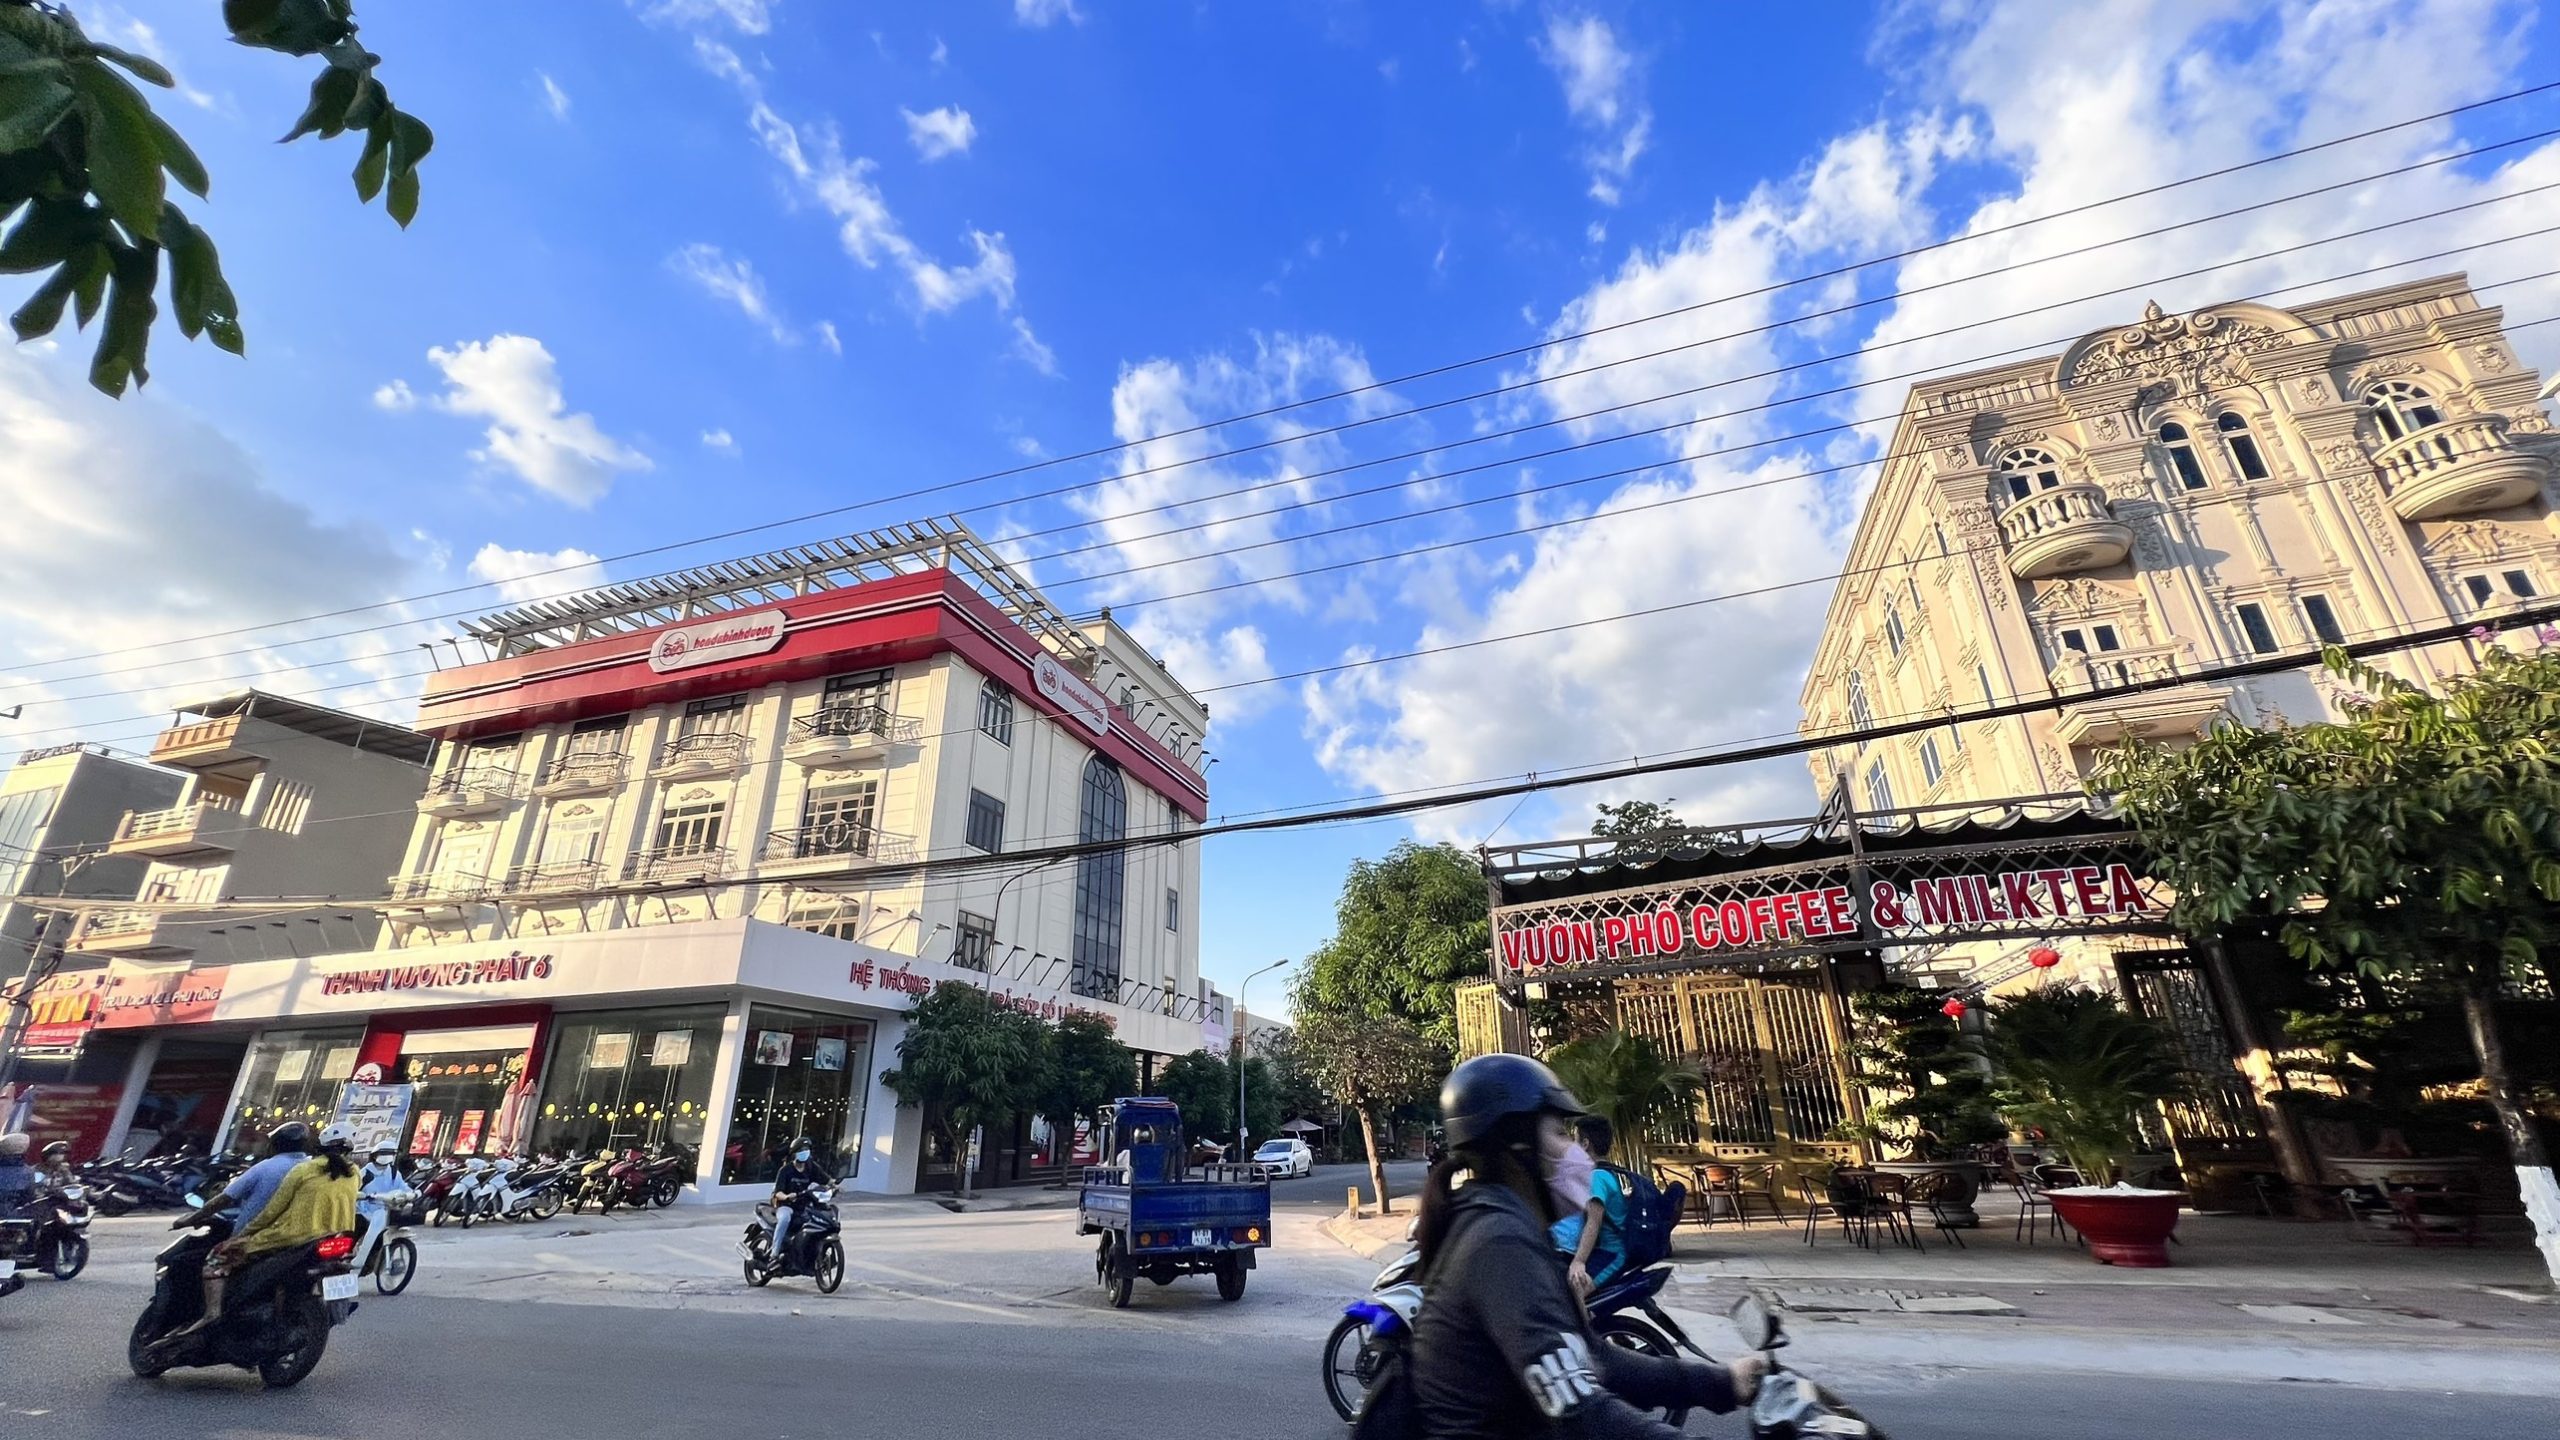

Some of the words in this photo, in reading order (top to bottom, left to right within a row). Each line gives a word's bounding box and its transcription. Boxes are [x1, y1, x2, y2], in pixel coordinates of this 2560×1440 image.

[1499, 912, 1599, 970] VƯỜN
[1689, 884, 1859, 950] COFFEE
[1869, 880, 1911, 930] &
[1911, 863, 2151, 928] MILKTEA
[321, 969, 388, 996] THANH
[472, 950, 532, 983] PHÁT
[533, 954, 553, 979] 6
[849, 958, 874, 991] HỆ
[879, 961, 931, 994] THỐNG
